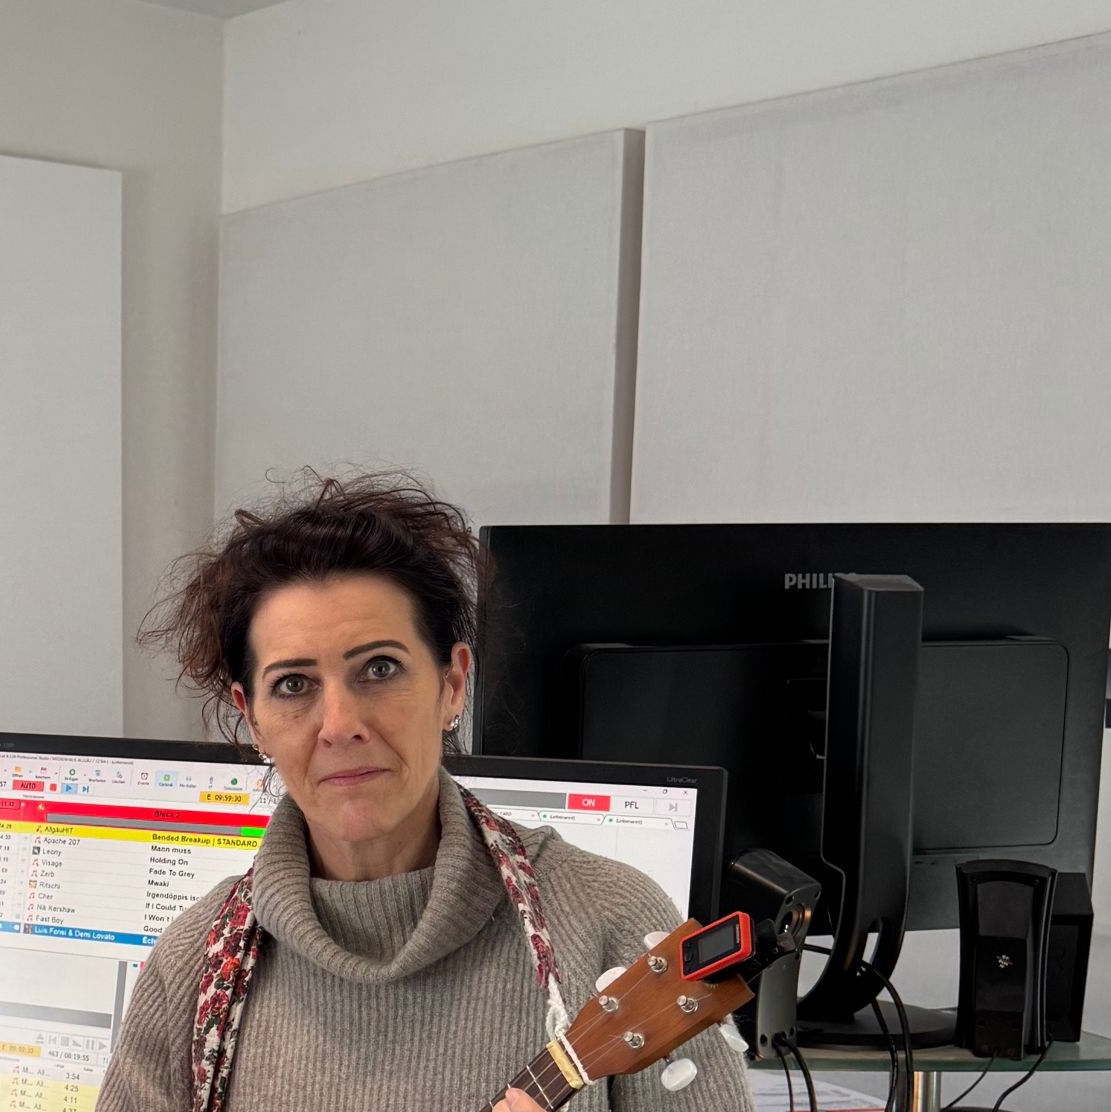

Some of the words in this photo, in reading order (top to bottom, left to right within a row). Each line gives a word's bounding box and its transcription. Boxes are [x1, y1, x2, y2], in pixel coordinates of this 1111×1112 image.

[784, 573, 855, 589] PHILI
[20, 782, 36, 790] AUTO
[582, 798, 596, 807] ON
[624, 801, 640, 809] PFL
[152, 833, 179, 842] Bended
[181, 836, 210, 845] Breakup
[151, 845, 170, 853] Mann
[42, 848, 62, 857] Leony
[150, 857, 176, 866] Holding
[41, 859, 62, 867] Visage
[149, 868, 166, 876] Fade
[168, 869, 176, 877] To
[178, 871, 195, 879] Grey
[148, 879, 169, 888] Mwaki
[38, 892, 53, 900] Cher
[190, 894, 200, 902] isc
[48, 905, 76, 913] Kershaw
[36, 915, 50, 923] Fast
[51, 916, 64, 925] Boy
[143, 925, 163, 933] Good
[34, 926, 48, 934] Luis
[49, 927, 67, 936] Fonsi
[92, 931, 115, 941] Lovato
[142, 936, 156, 944] Éch
